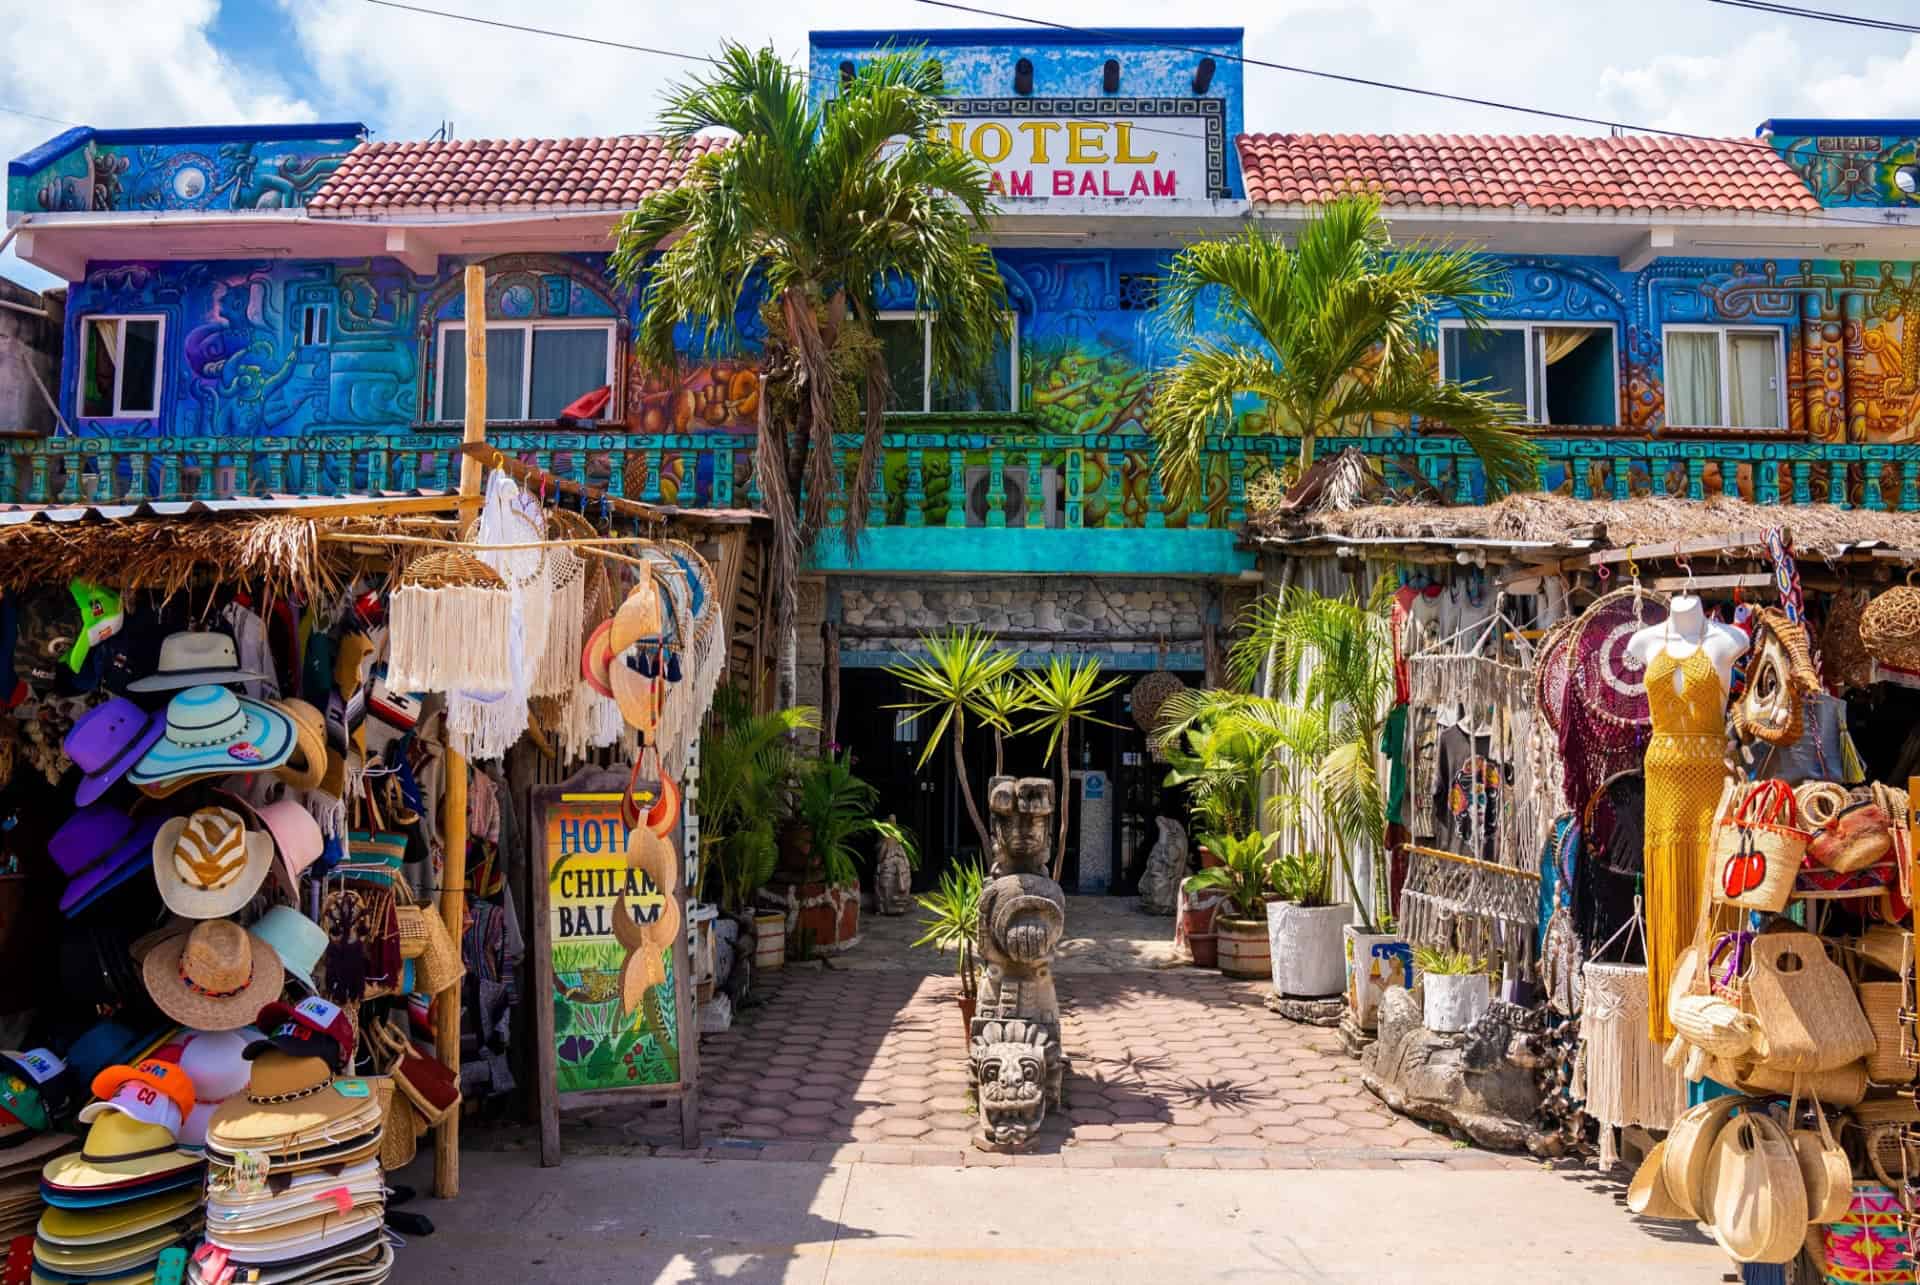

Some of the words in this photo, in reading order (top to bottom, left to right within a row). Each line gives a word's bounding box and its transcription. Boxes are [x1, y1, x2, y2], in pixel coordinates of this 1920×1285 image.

[1052, 170, 1176, 196] BALAM
[560, 818, 629, 854] HOT
[559, 904, 661, 937] BALM
